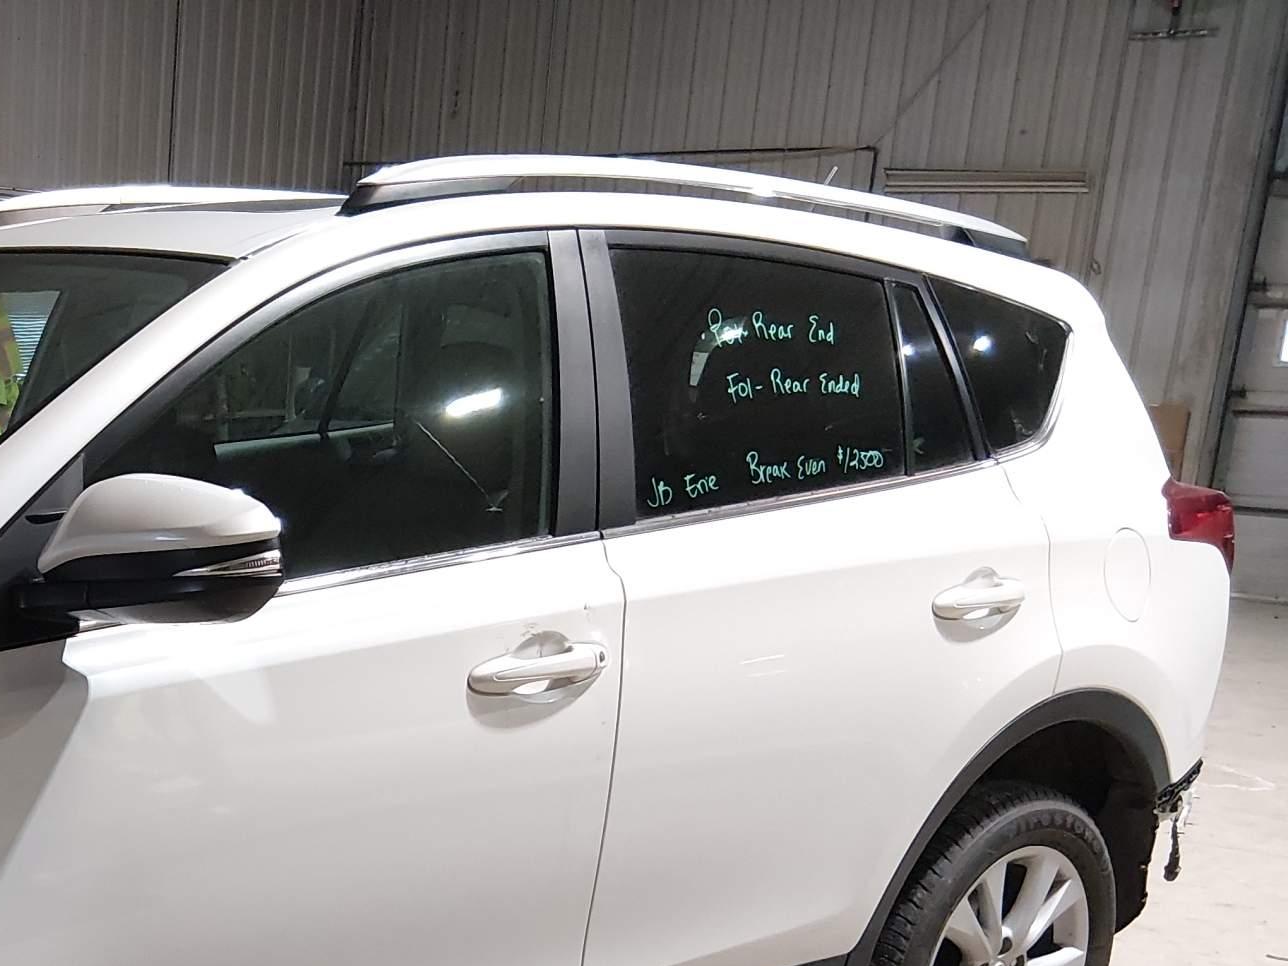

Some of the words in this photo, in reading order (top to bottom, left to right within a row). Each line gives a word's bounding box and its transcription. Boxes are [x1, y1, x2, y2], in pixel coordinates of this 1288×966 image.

[751, 311, 794, 341] Rear
[808, 315, 835, 345] End
[770, 368, 810, 395] Rear
[818, 372, 861, 398] Ended
[683, 473, 720, 499] Erie
[796, 455, 826, 480] Even
